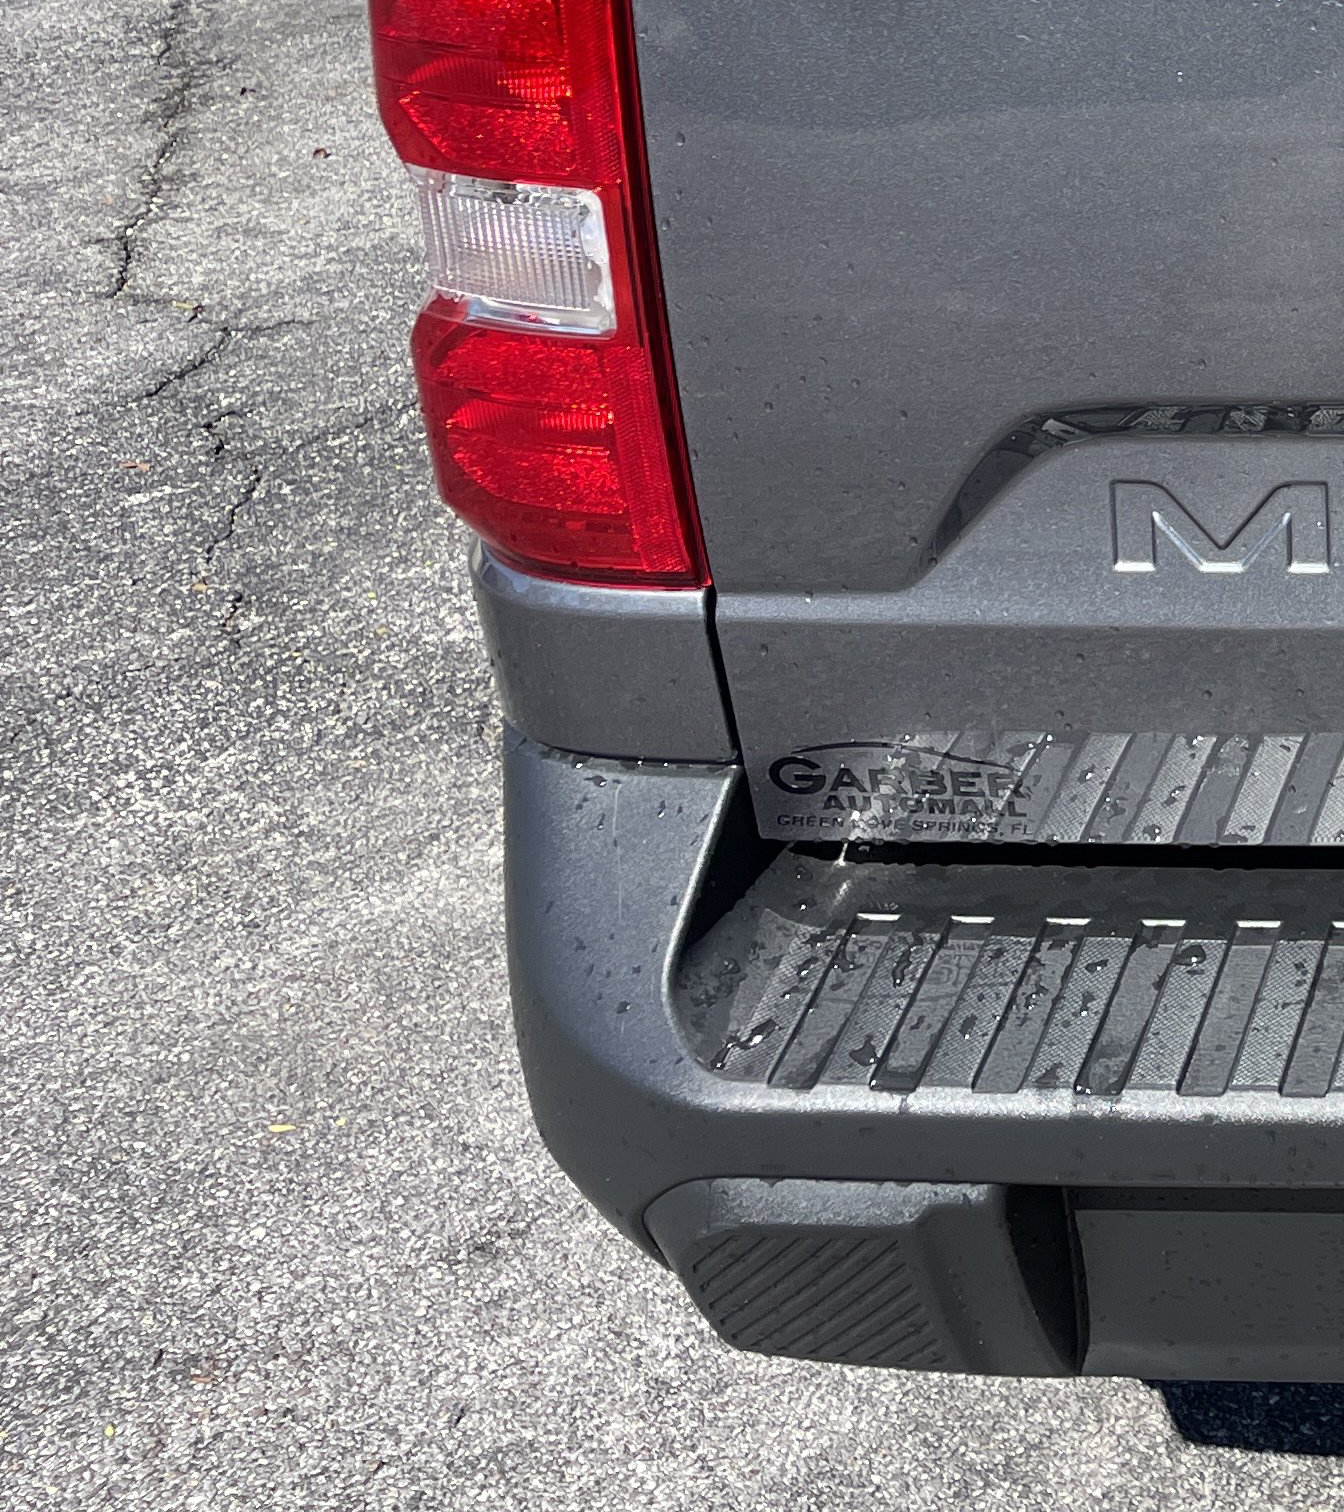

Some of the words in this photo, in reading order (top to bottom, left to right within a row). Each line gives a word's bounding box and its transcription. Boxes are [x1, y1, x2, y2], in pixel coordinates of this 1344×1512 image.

[768, 755, 1027, 798] GARBER
[822, 794, 1027, 817] AUTOMALL
[776, 814, 845, 828] GREEN
[1010, 822, 1034, 836] FL
